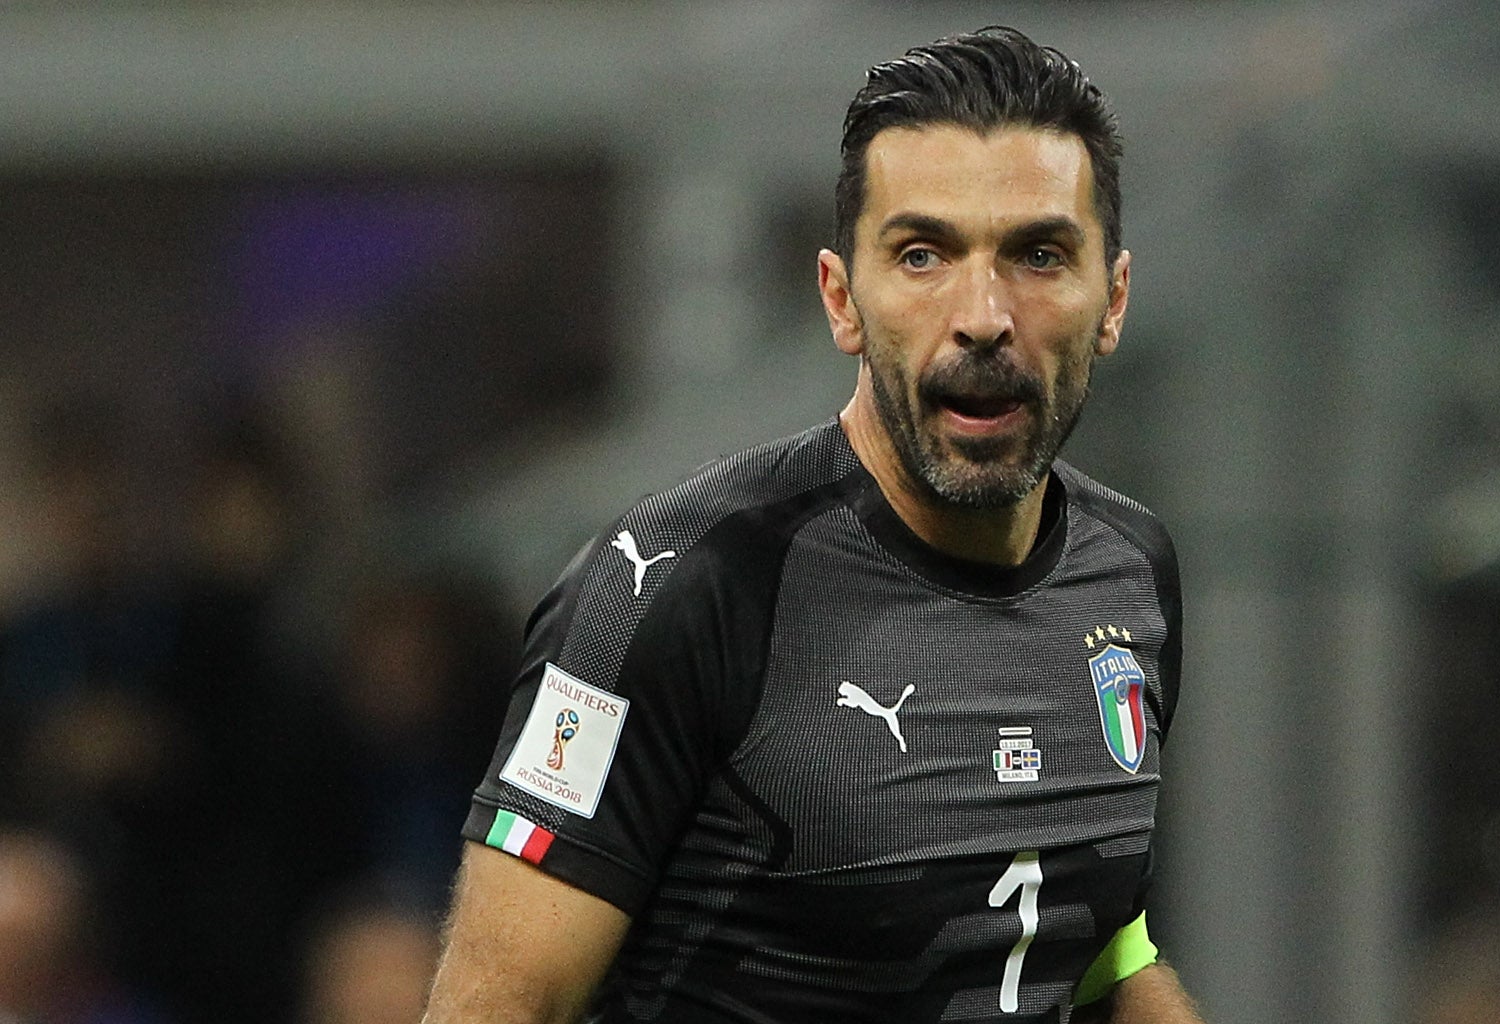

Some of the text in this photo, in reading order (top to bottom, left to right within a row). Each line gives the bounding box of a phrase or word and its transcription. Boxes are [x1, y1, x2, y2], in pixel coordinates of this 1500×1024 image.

[1094, 655, 1138, 682] ITALIA
[546, 674, 619, 717] QUALIFIERS
[516, 767, 582, 804] RUSSIA 2018
[988, 851, 1043, 1013] 1
